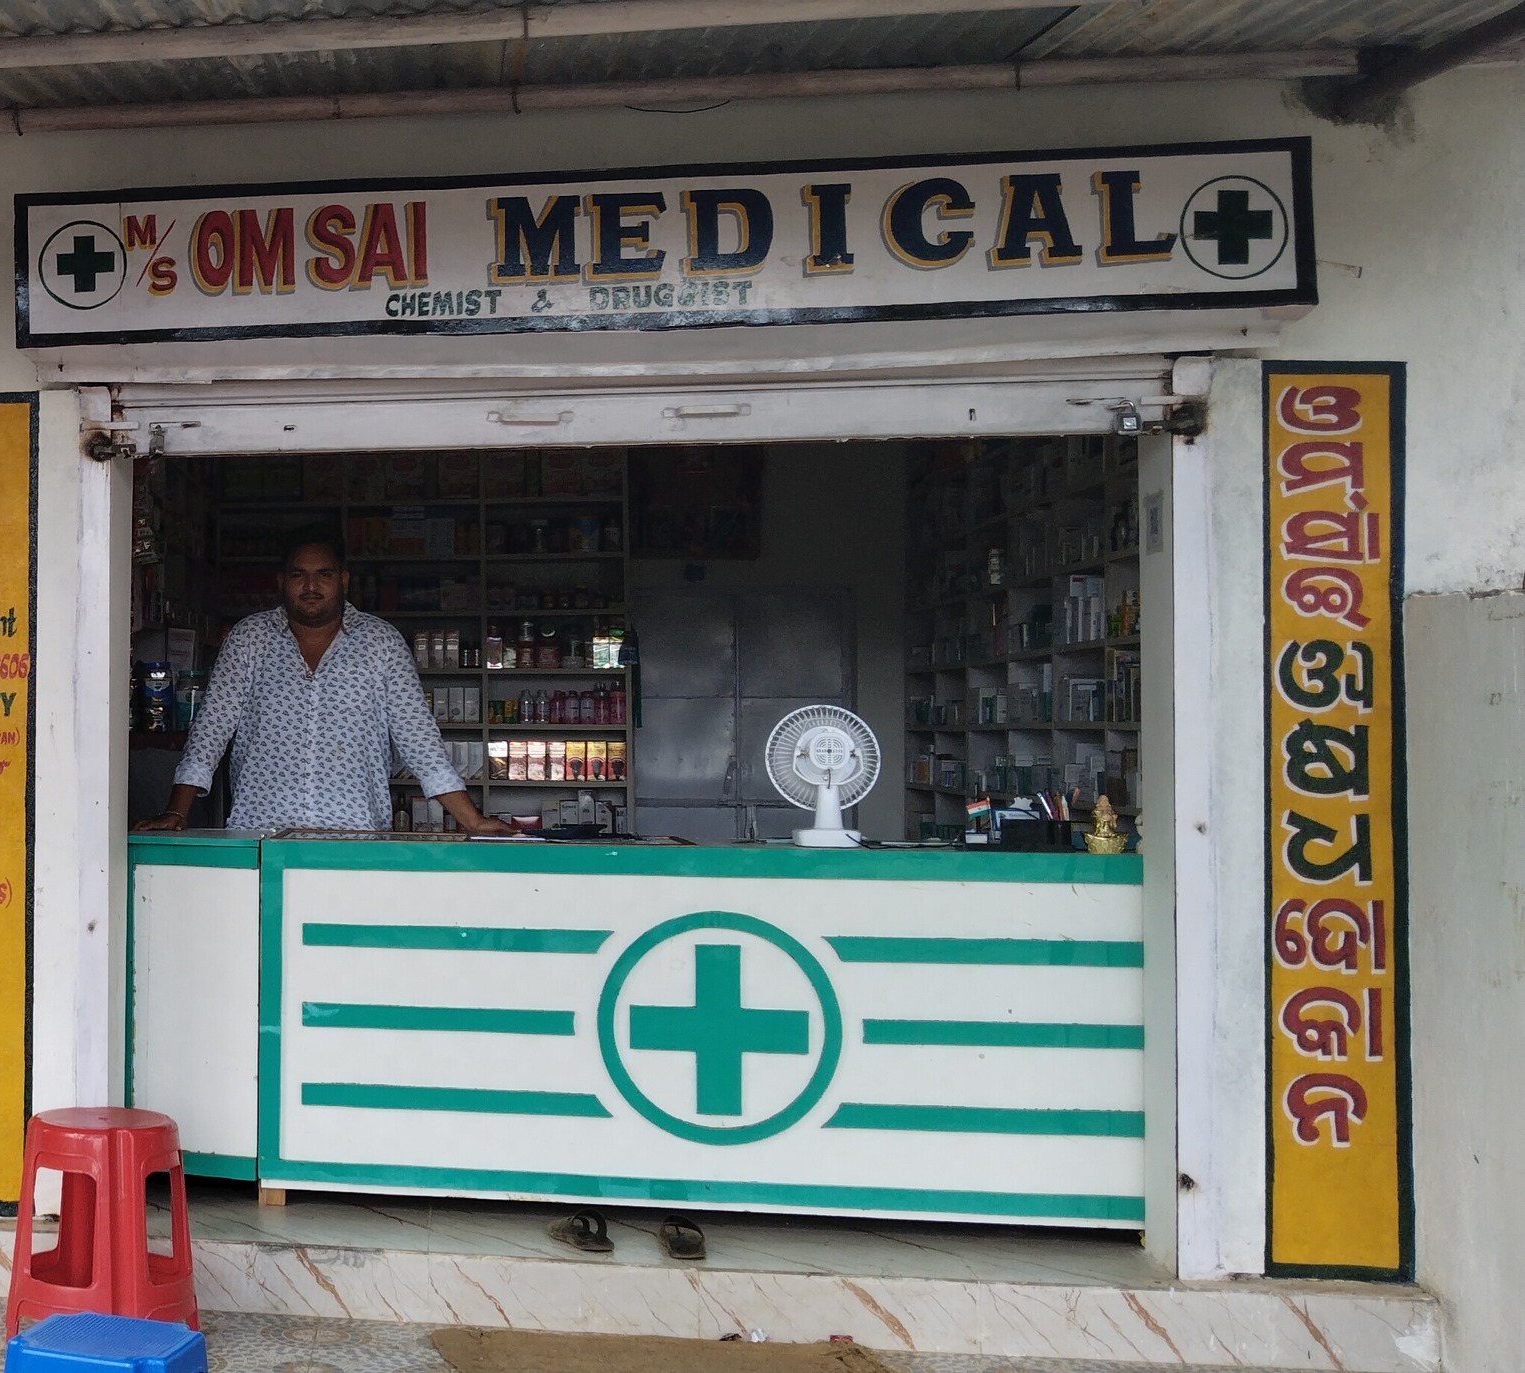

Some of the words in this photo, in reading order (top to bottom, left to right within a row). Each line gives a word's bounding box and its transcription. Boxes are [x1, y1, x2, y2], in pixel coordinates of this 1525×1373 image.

[188, 208, 296, 295] OM
[305, 201, 428, 291] SAI
[488, 170, 1178, 285] MEDICAL
[384, 289, 502, 317] CHEMIST
[530, 289, 555, 313] &
[589, 280, 753, 311] DRUGGIST
